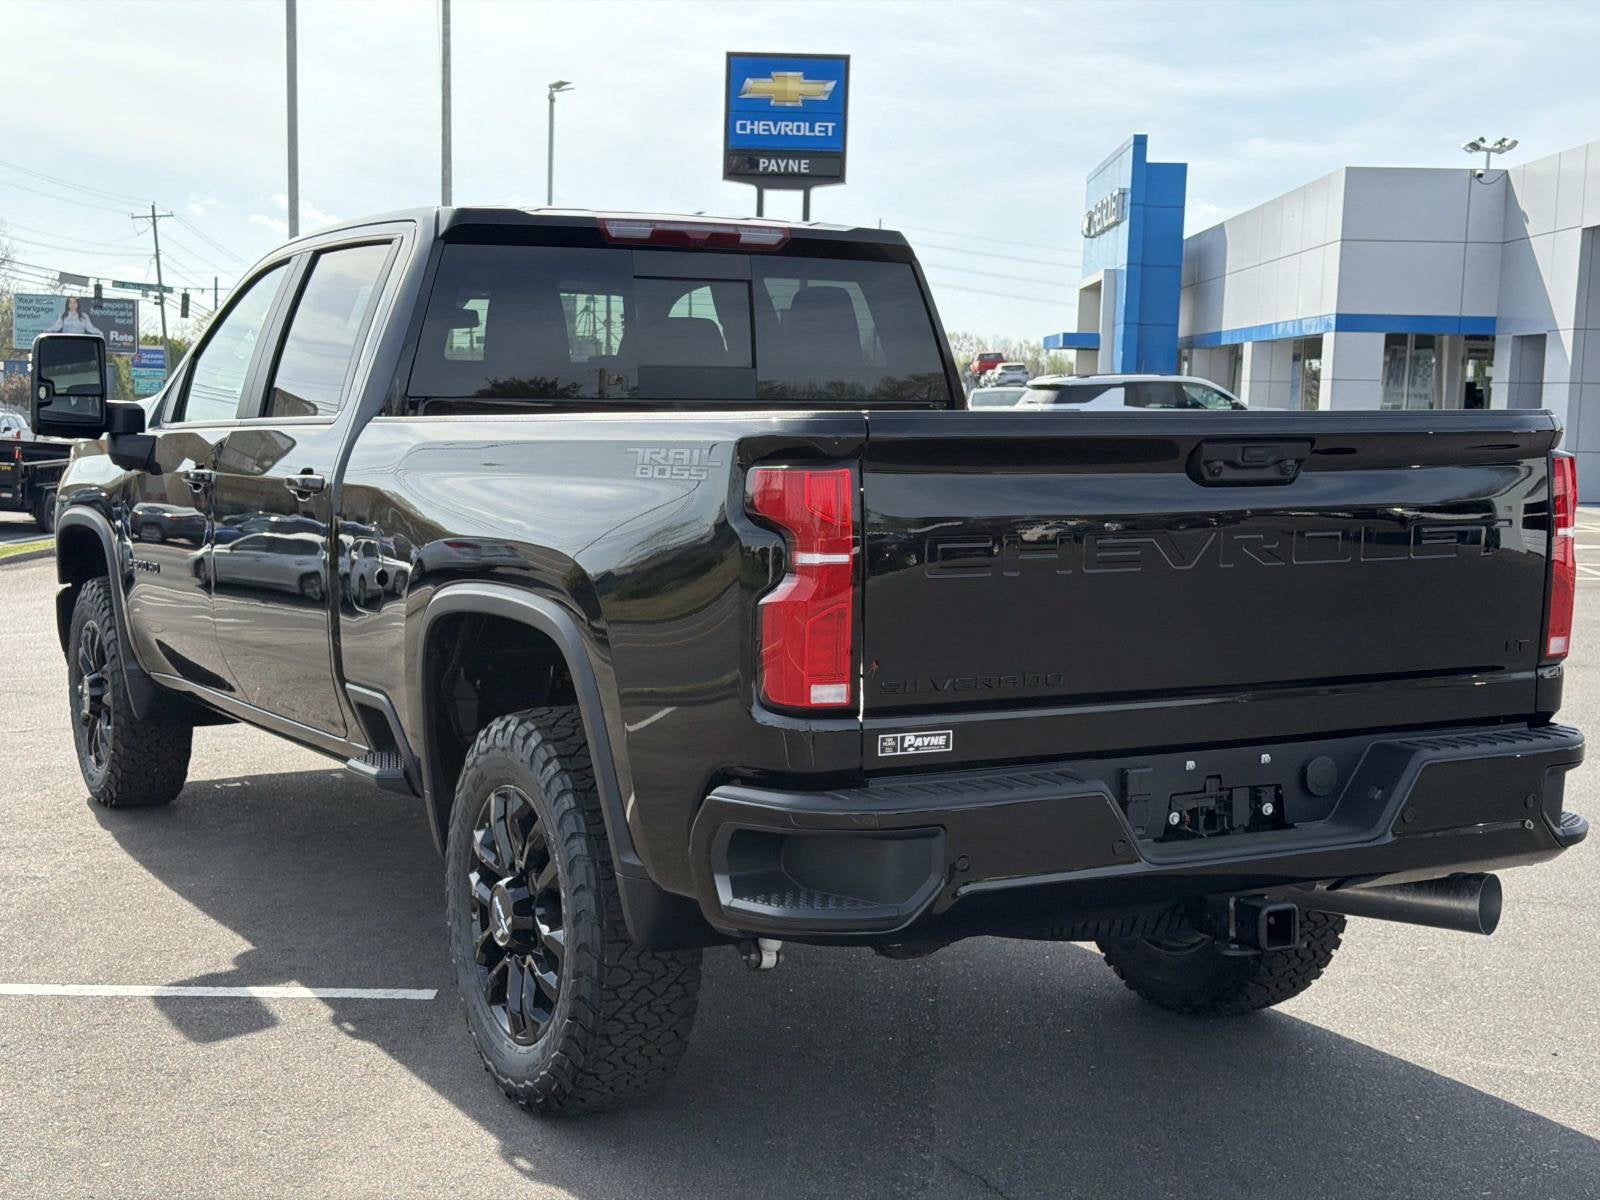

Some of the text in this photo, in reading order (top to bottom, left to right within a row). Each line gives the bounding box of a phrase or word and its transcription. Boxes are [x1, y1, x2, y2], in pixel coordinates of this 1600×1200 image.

[735, 120, 836, 137] CHEVROLET
[758, 158, 810, 173] PAYNE
[16, 305, 54, 313] mortgage
[109, 330, 134, 342] Rate
[626, 447, 722, 467] TRAIL
[635, 465, 710, 480] BOSS
[925, 518, 1512, 579] CHEVROLET
[880, 671, 1065, 695] SILVERADO
[904, 735, 947, 748] PAYNE
